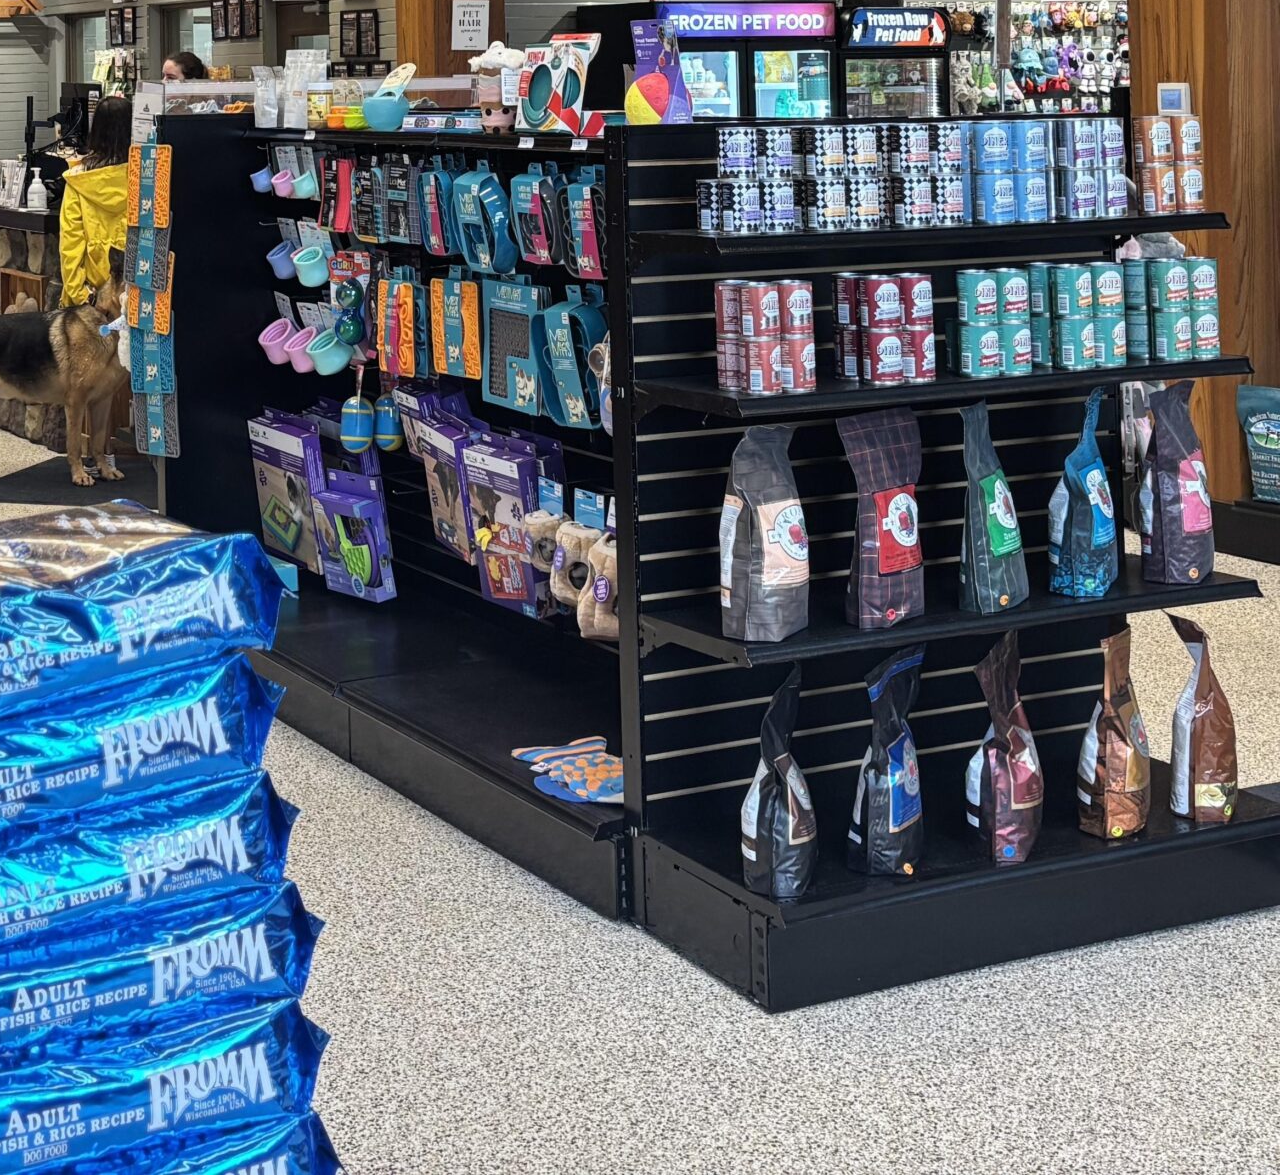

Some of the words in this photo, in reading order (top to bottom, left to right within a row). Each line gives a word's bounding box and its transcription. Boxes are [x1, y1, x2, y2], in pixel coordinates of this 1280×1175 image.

[459, 19, 481, 27] HAIR
[463, 10, 480, 18] PET
[669, 14, 737, 31] FROZEN
[742, 14, 771, 30] PET
[777, 13, 825, 30] FOOD
[867, 12, 899, 27] Frozen
[901, 12, 929, 27] Raw
[875, 28, 893, 42] Pet
[894, 27, 922, 42] Food
[331, 258, 353, 270] GURU
[109, 570, 245, 664] FROMM
[60, 640, 115, 665] RECIPE
[98, 696, 231, 789] FROMM
[139, 760, 183, 777] Wisconsin,
[183, 753, 200, 766] USA
[148, 754, 170, 767] Since
[6, 780, 41, 802] RICE
[45, 763, 100, 789] RECIPE
[123, 814, 253, 903] FROMM
[170, 871, 193, 884] Since
[206, 871, 223, 883] USA
[14, 909, 27, 922] &
[69, 880, 124, 906] RECIPE
[24, 918, 49, 932] FOOD
[148, 922, 277, 1006] FROMM
[195, 976, 218, 989] Since
[230, 977, 246, 989] USA
[13, 978, 87, 1013] ADULT
[40, 1009, 53, 1023] &
[56, 997, 91, 1019] RICE
[94, 984, 148, 1007] RECIPE
[146, 1041, 277, 1132] FROMM
[184, 1105, 228, 1122] Wisconsin,
[228, 1097, 246, 1110] USA
[193, 1098, 216, 1112] Since
[217, 1092, 236, 1106] 1904
[6, 1102, 82, 1137] ADULT
[33, 1132, 45, 1146] &
[48, 1120, 86, 1141] RICE
[90, 1107, 145, 1131] RECIPE
[23, 1148, 43, 1165] DOG
[44, 1142, 68, 1159] FOOD
